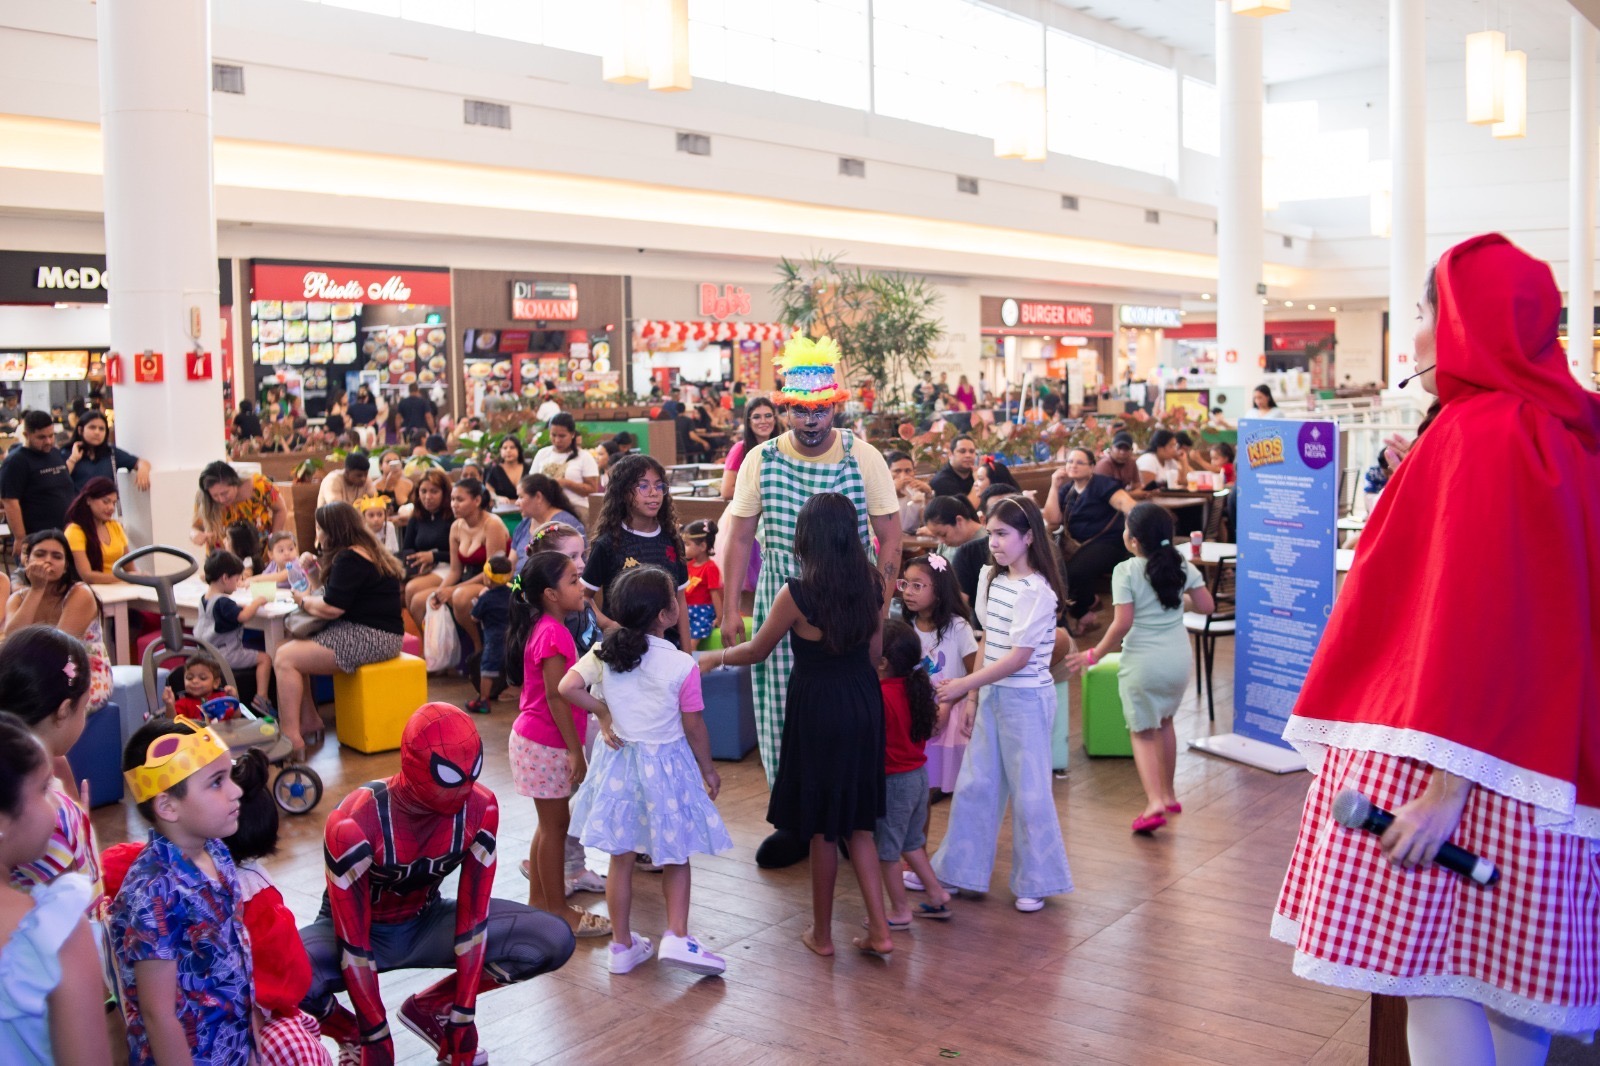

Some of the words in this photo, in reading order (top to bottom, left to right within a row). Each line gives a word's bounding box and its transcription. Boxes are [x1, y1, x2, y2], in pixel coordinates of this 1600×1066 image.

[303, 271, 364, 299] Risotto
[514, 301, 577, 319] ROMANI
[700, 283, 751, 320] Bob's
[1021, 303, 1065, 324] BURGER
[1066, 306, 1093, 325] KING
[1247, 437, 1283, 462] KIDS
